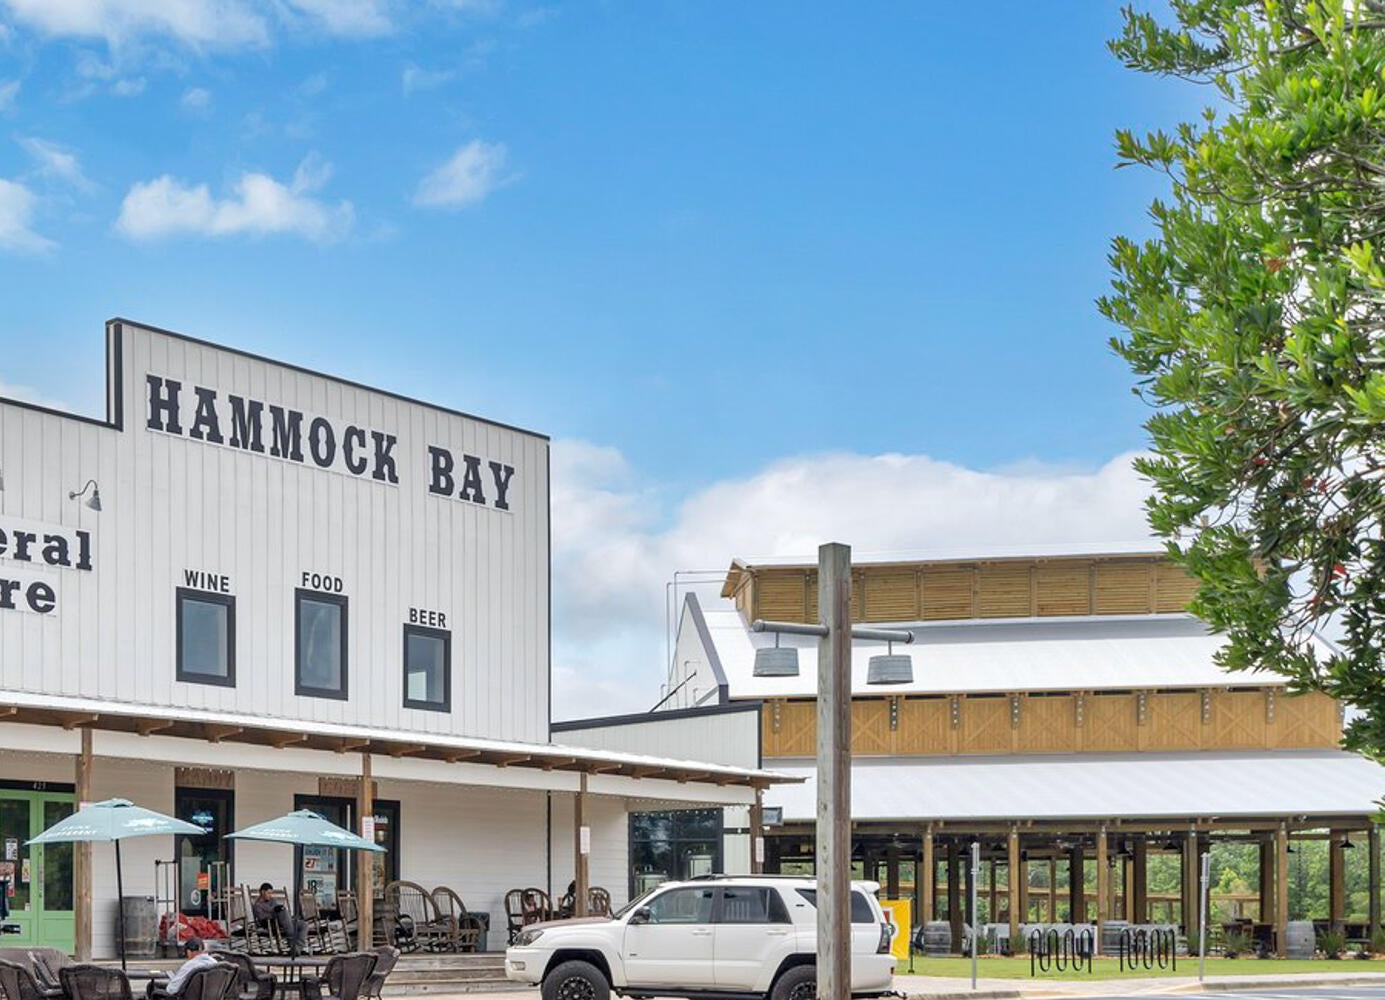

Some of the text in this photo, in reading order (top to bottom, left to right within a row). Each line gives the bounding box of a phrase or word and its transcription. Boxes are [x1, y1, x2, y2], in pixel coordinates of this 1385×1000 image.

[146, 374, 515, 511] HAMMOCK BAY
[184, 569, 230, 593] WINE
[301, 571, 343, 593] FOOD
[409, 607, 447, 628] BEER
